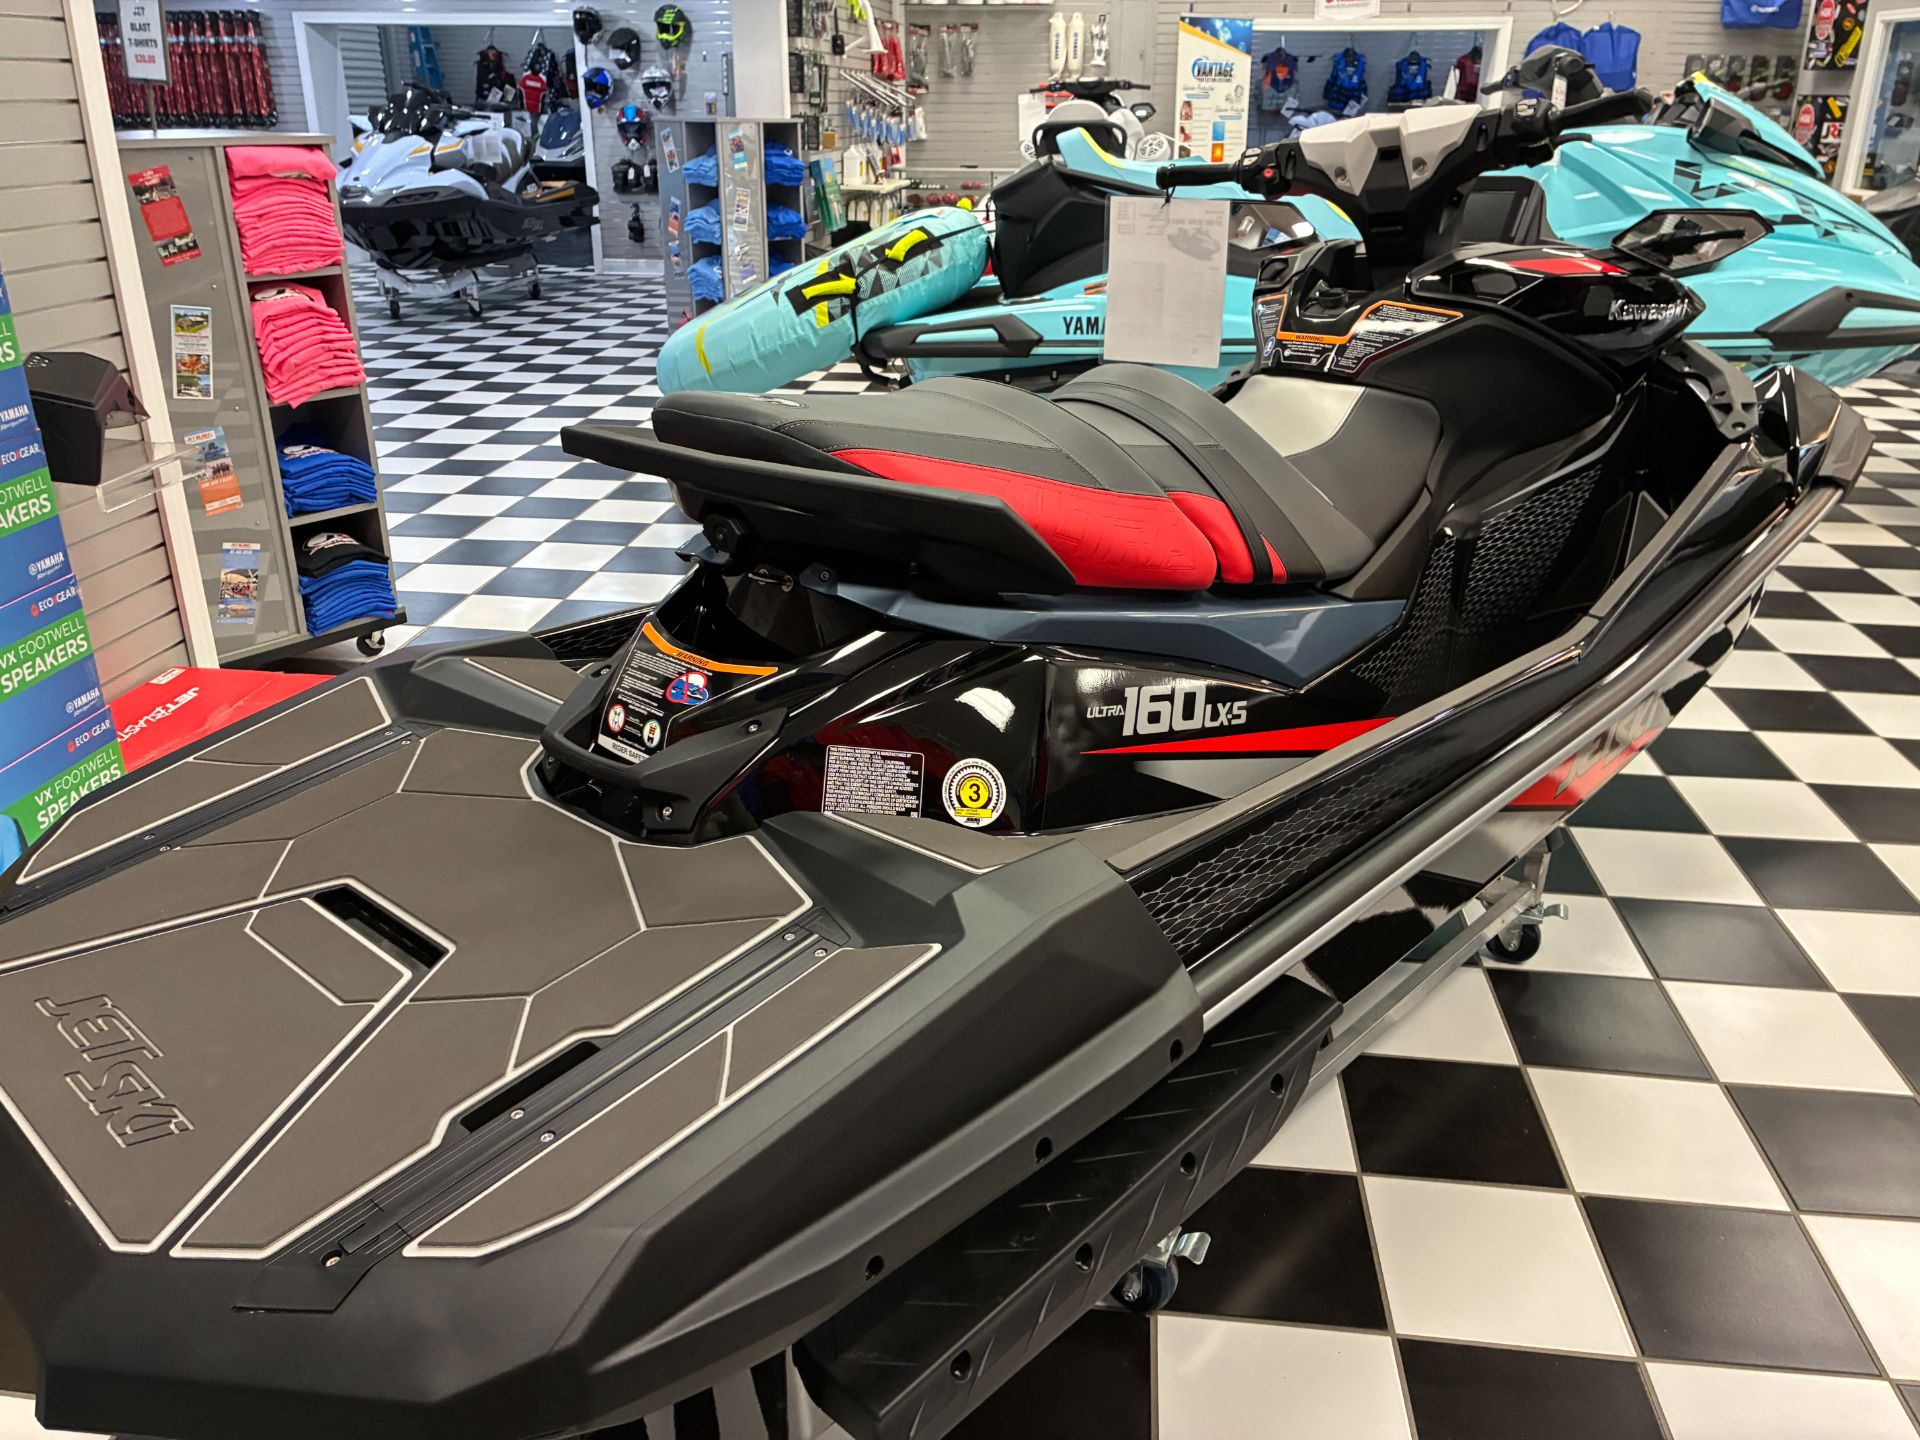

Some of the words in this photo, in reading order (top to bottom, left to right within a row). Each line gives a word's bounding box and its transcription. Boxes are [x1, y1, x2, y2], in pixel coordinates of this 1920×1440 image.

[130, 22, 151, 32] BLAST
[128, 38, 158, 49] T-SHIRTS
[1195, 61, 1235, 78] VANTAGE
[1608, 298, 1689, 321] Kawasaki
[0, 404, 30, 423] YAMAHA
[35, 551, 65, 573] YAMAHA
[0, 650, 18, 669] VX
[18, 617, 84, 660] FOOTWELL
[1, 633, 88, 693] SPEAKERS
[676, 650, 709, 668] WARNING
[73, 687, 101, 709] YAMAHA
[1086, 704, 1125, 719] ULTRA
[1122, 685, 1207, 737] 160
[612, 743, 628, 755] RIDER
[628, 750, 647, 761] SAFET
[34, 786, 54, 806] VX
[54, 748, 118, 795] FOOTWELL
[36, 763, 122, 830] SPEAKERS
[968, 783, 981, 803] 3
[33, 994, 165, 1062] JET
[64, 1060, 195, 1148] SKI
